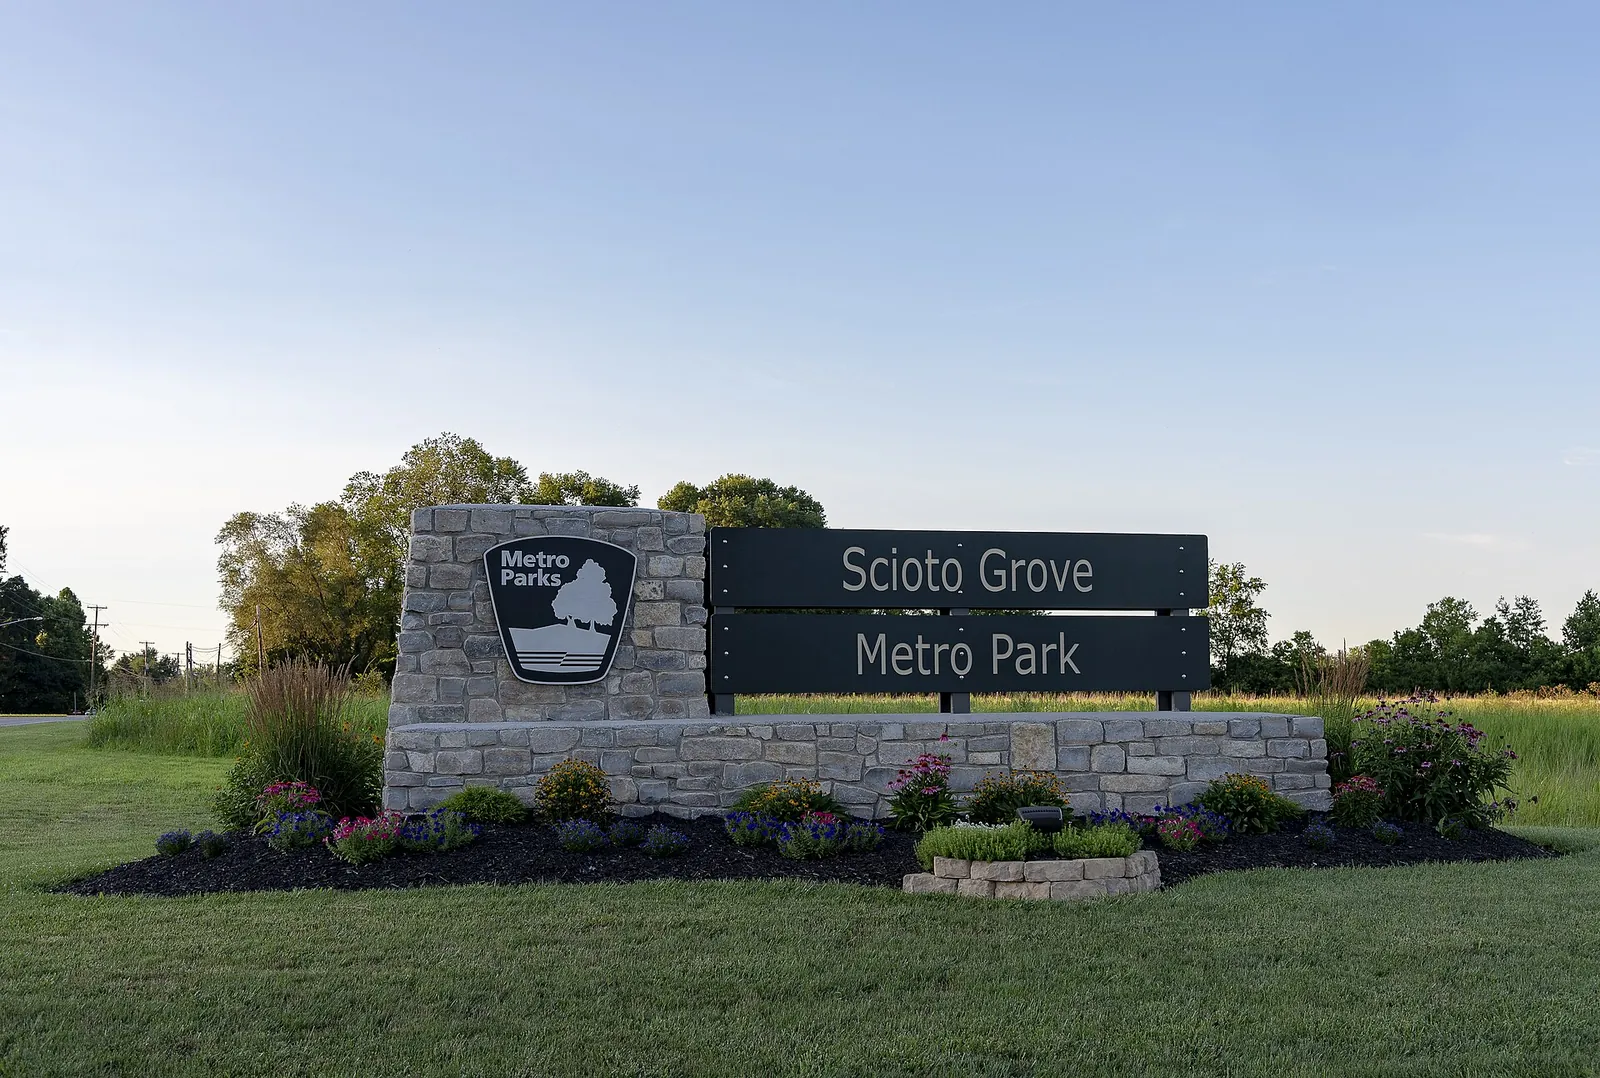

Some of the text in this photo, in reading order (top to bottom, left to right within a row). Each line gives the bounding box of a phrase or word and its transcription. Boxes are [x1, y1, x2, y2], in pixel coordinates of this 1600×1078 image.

[501, 550, 570, 568] Metro
[842, 546, 1094, 593] Scioto Grove
[501, 569, 562, 586] Parks
[856, 631, 1081, 676] Metro Park
